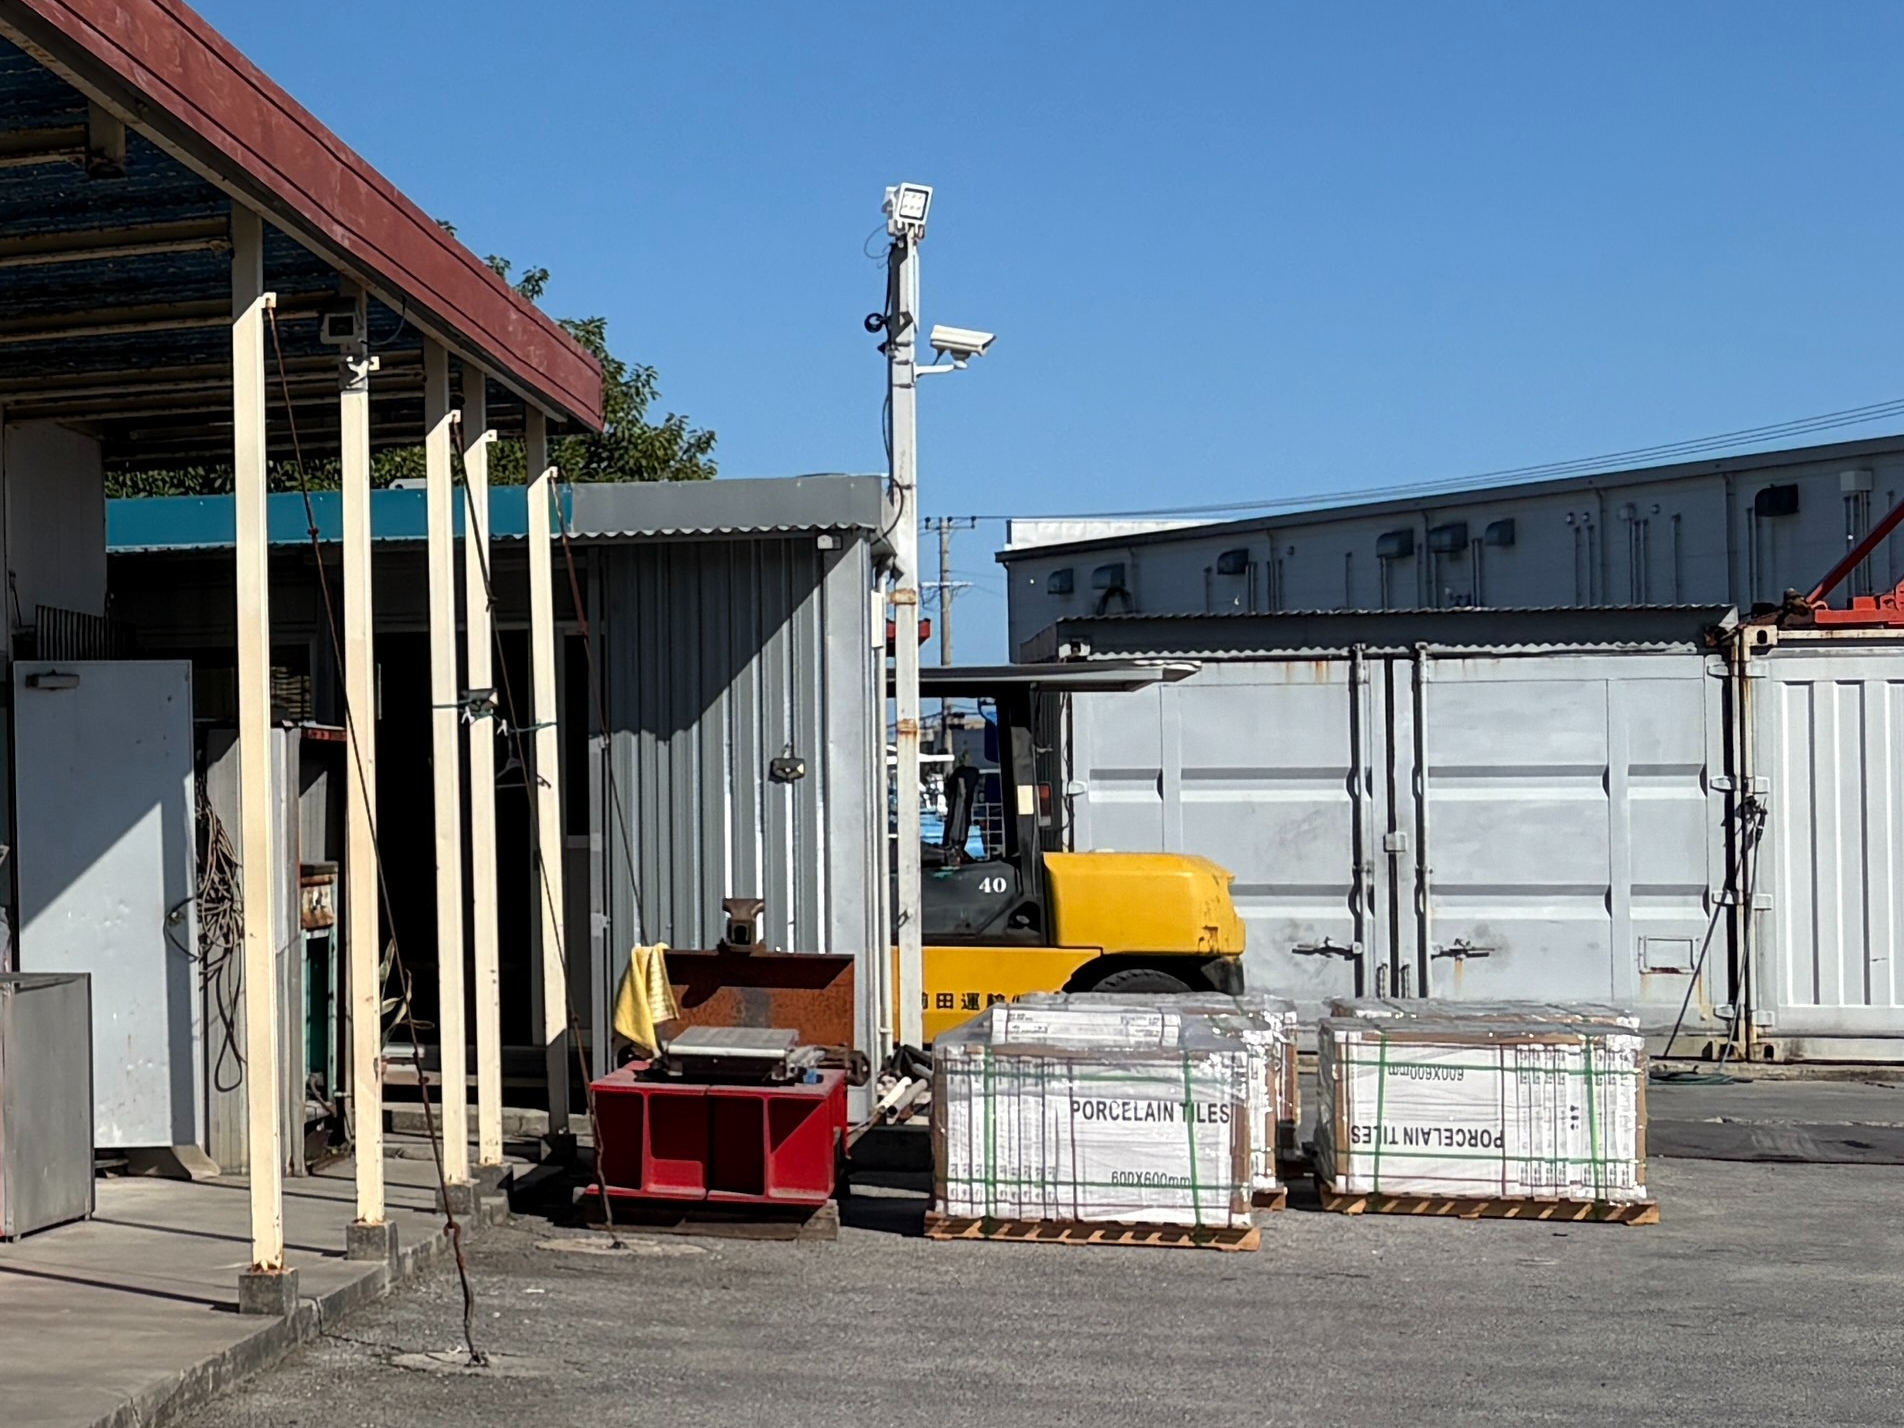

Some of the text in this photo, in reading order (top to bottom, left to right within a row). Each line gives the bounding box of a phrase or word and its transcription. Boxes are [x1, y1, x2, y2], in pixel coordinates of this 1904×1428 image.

[978, 876, 1007, 894] 40
[1072, 1100, 1175, 1122] PORCELAIN
[1404, 1127, 1505, 1149] PORCELAIN
